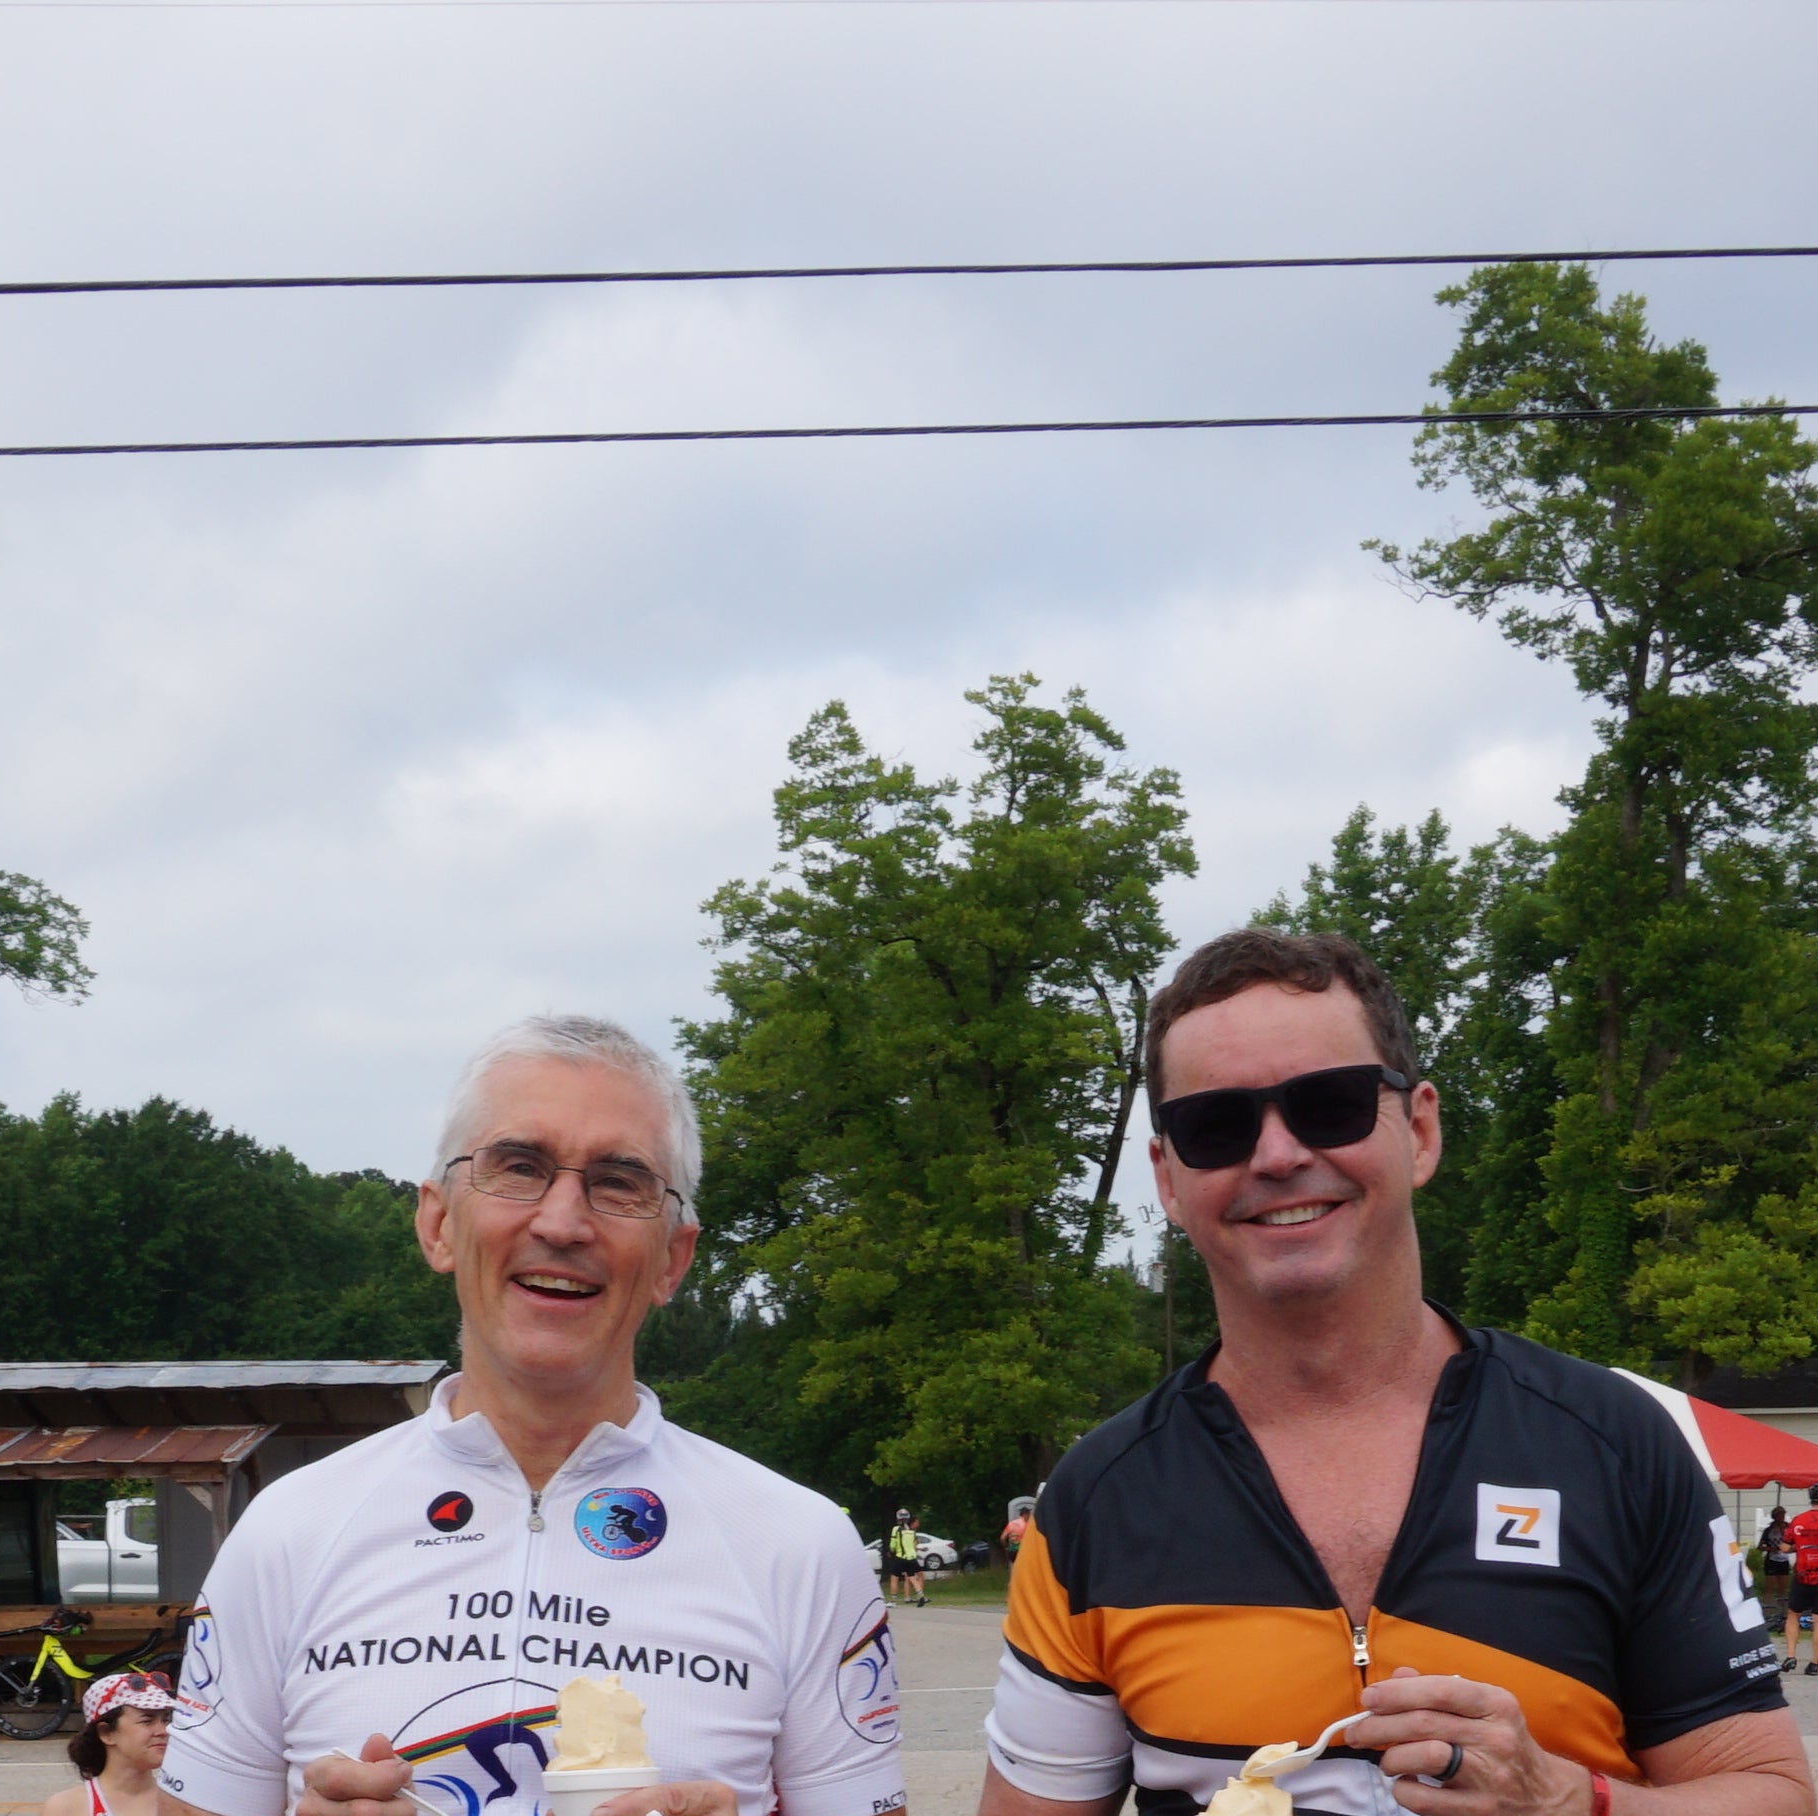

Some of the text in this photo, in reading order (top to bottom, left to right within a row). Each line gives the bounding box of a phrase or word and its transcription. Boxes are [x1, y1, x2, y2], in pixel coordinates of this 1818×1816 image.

[414, 1533, 485, 1547] PACTIMO
[448, 1590, 612, 1627] 100 Mile
[304, 1633, 750, 1691] NATIONAL CHAMPION
